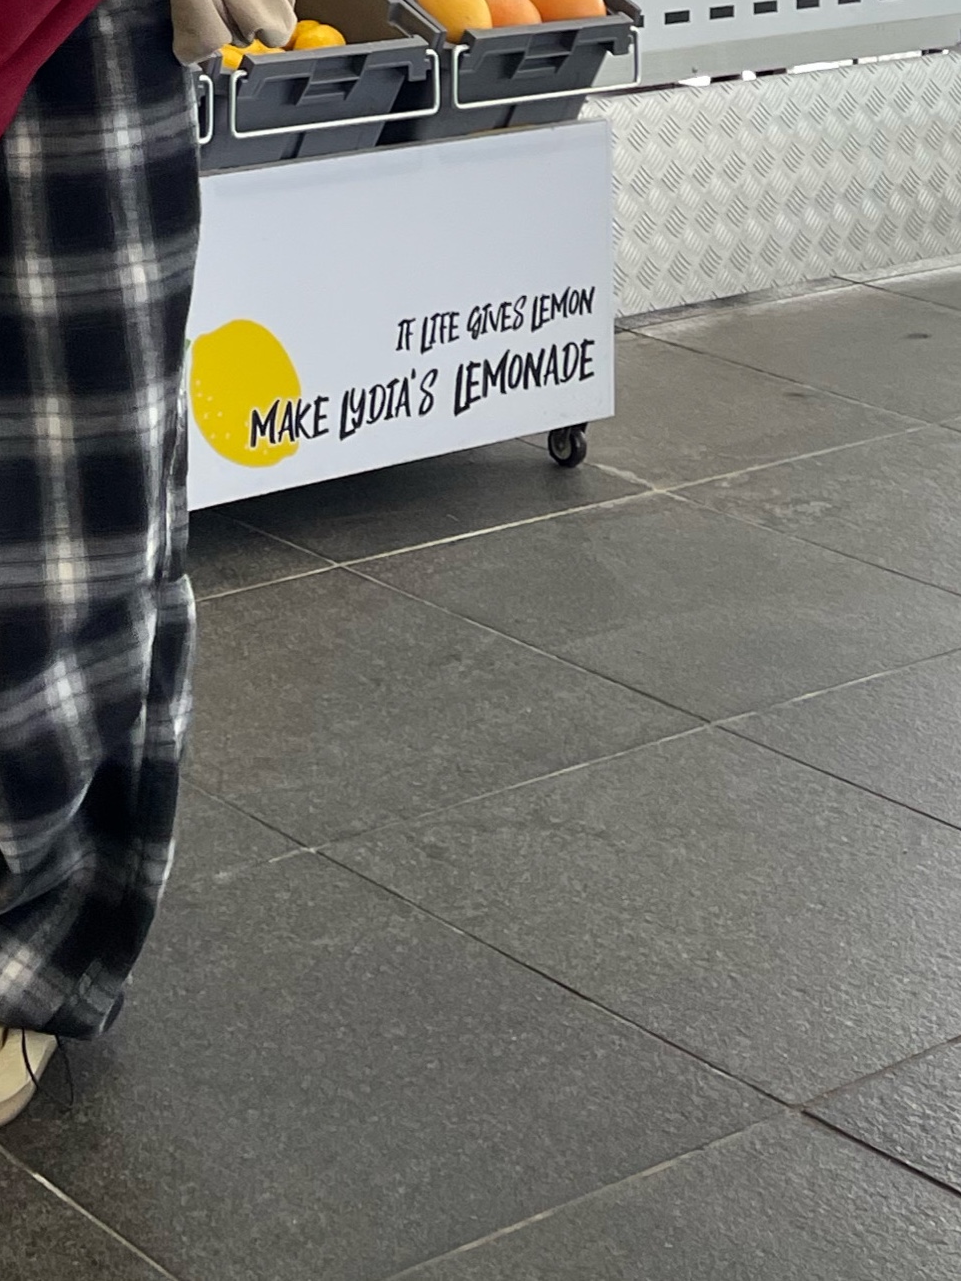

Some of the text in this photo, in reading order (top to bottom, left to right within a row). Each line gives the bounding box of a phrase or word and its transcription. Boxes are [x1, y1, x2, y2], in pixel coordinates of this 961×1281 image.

[420, 310, 461, 354] LIFE
[467, 295, 527, 341] GIVES
[530, 286, 596, 334] LEMON
[249, 339, 596, 449] MAKE LYDIA'S LEMONADE
